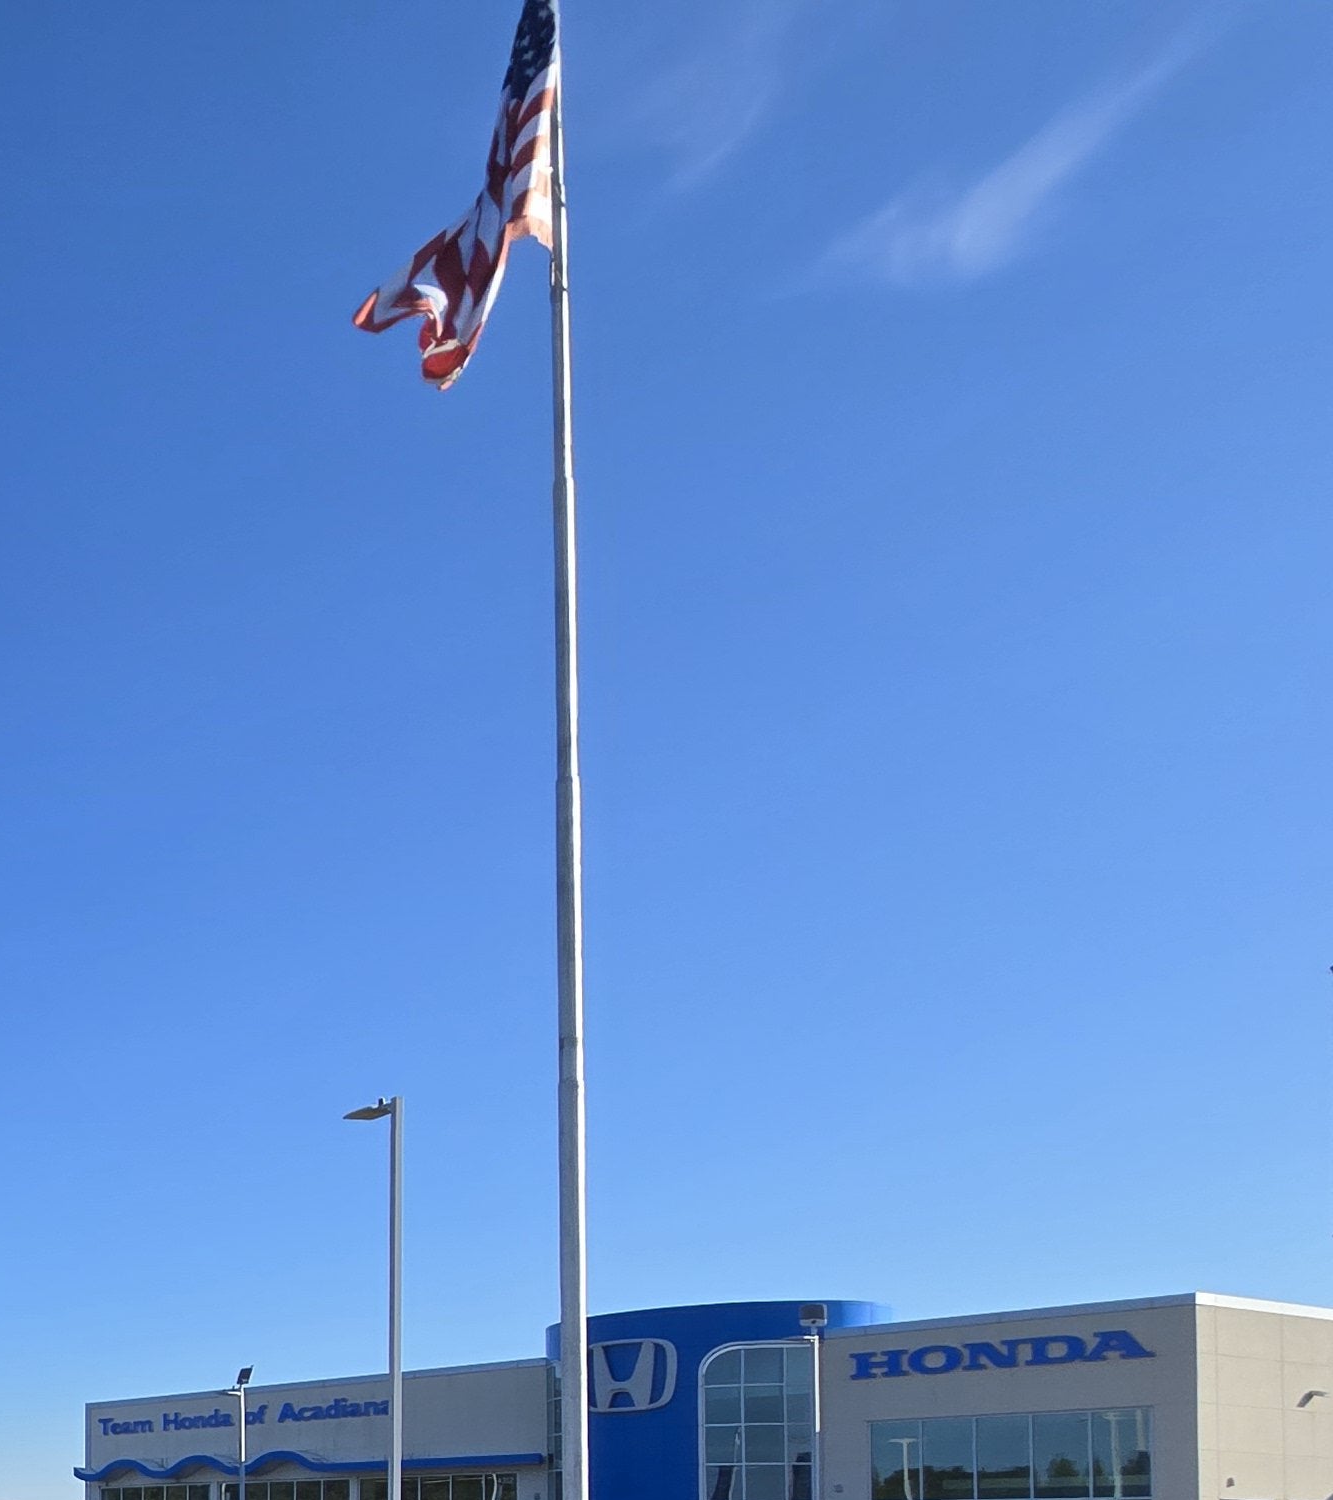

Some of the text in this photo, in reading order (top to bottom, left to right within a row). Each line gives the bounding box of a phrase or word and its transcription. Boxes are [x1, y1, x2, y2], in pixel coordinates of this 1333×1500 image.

[849, 1329, 1157, 1380] HONDA
[98, 1397, 390, 1436] Team Honda of Acadiana
